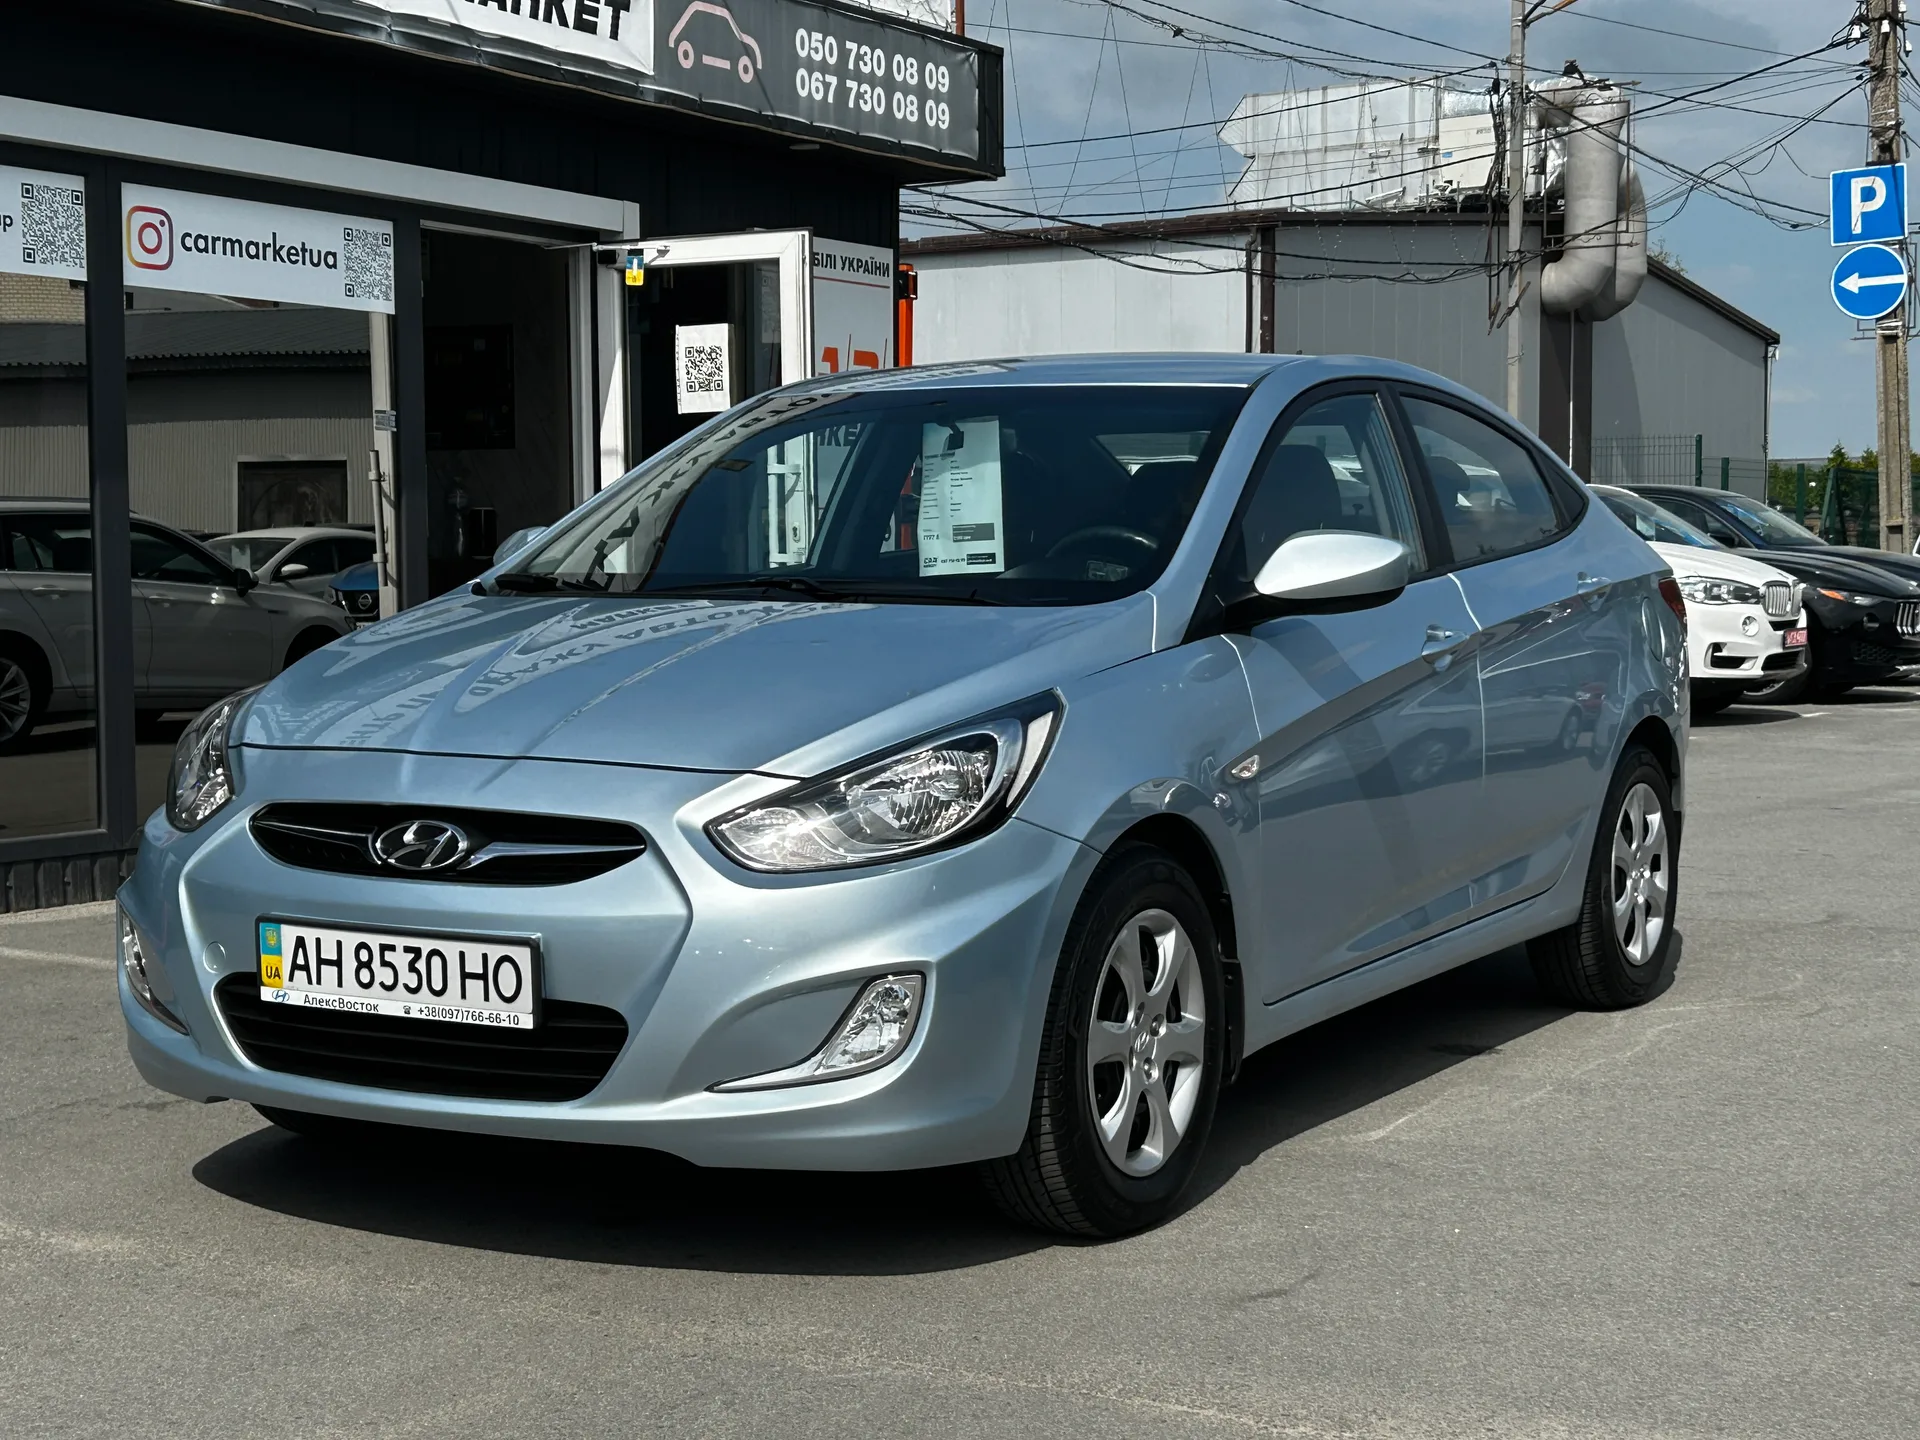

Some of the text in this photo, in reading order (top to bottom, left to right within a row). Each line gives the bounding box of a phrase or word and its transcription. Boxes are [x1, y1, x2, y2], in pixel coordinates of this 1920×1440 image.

[795, 28, 950, 93] 050 730 08 09
[795, 67, 950, 130] 067 730 08 09
[1850, 175, 1887, 235] P
[180, 230, 339, 271] carmarketua
[813, 251, 890, 278] БІЛІ УКРАЇНИ
[265, 964, 282, 980] UA
[288, 935, 523, 1004] AH 8530 HO
[303, 993, 520, 1027] АлексВосток +38(097)766-66-10
